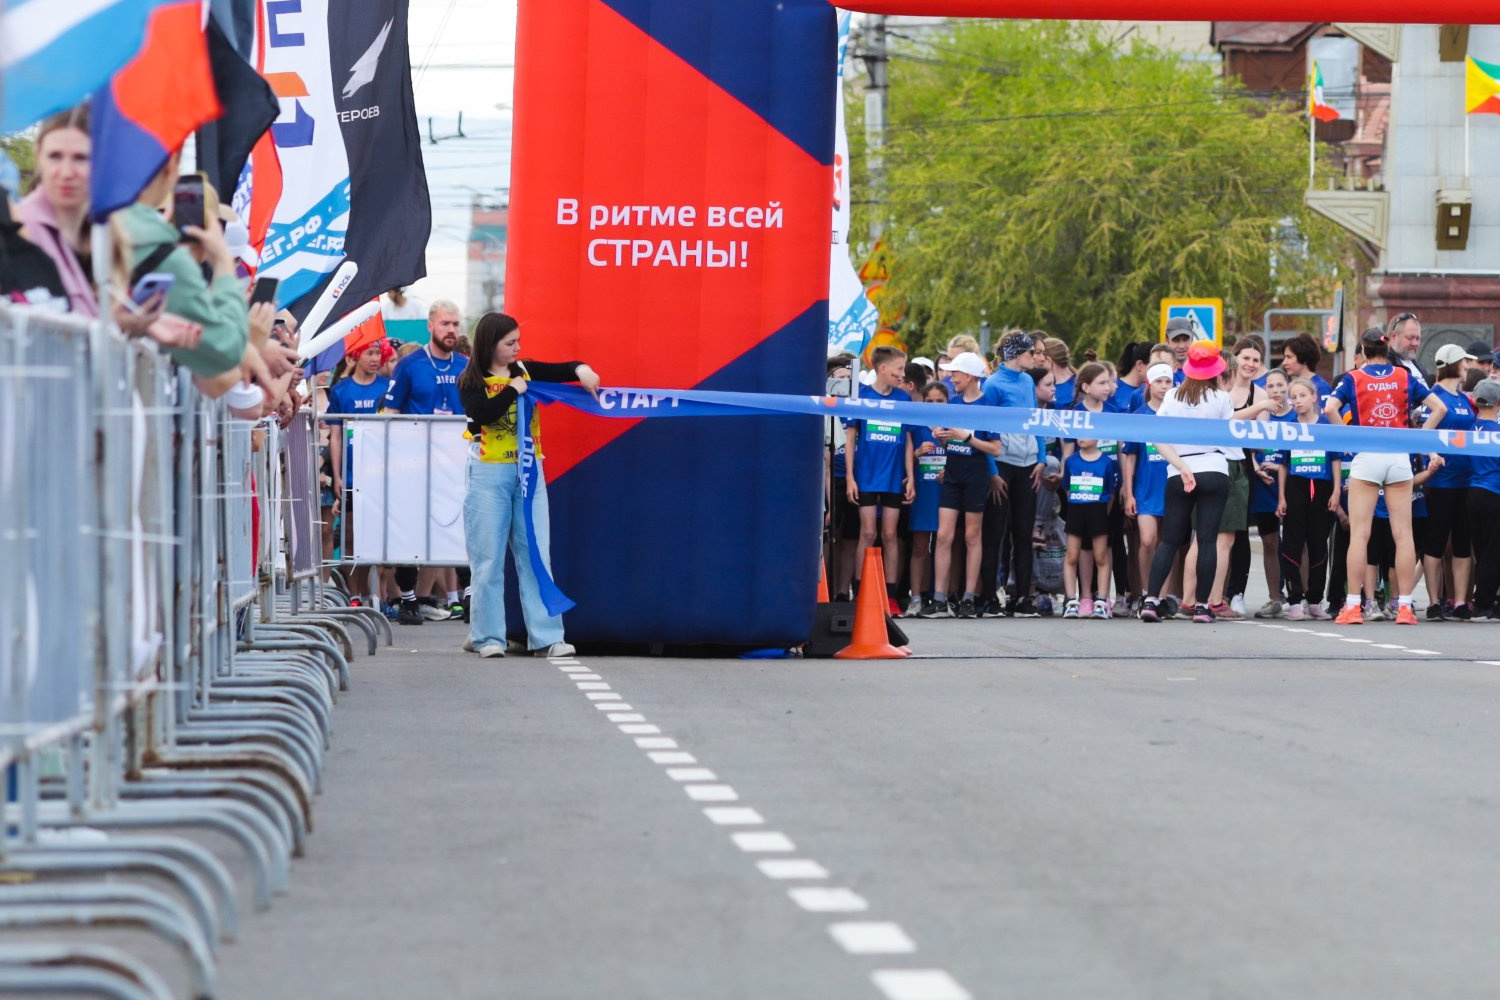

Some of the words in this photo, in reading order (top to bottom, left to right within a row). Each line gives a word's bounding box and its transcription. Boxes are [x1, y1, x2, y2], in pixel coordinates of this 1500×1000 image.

[556, 198, 579, 225] В
[590, 203, 696, 230] ритме
[706, 201, 784, 229] всей
[586, 239, 749, 267] СТРАНЫ!
[1367, 382, 1399, 391] СУДЬЯ
